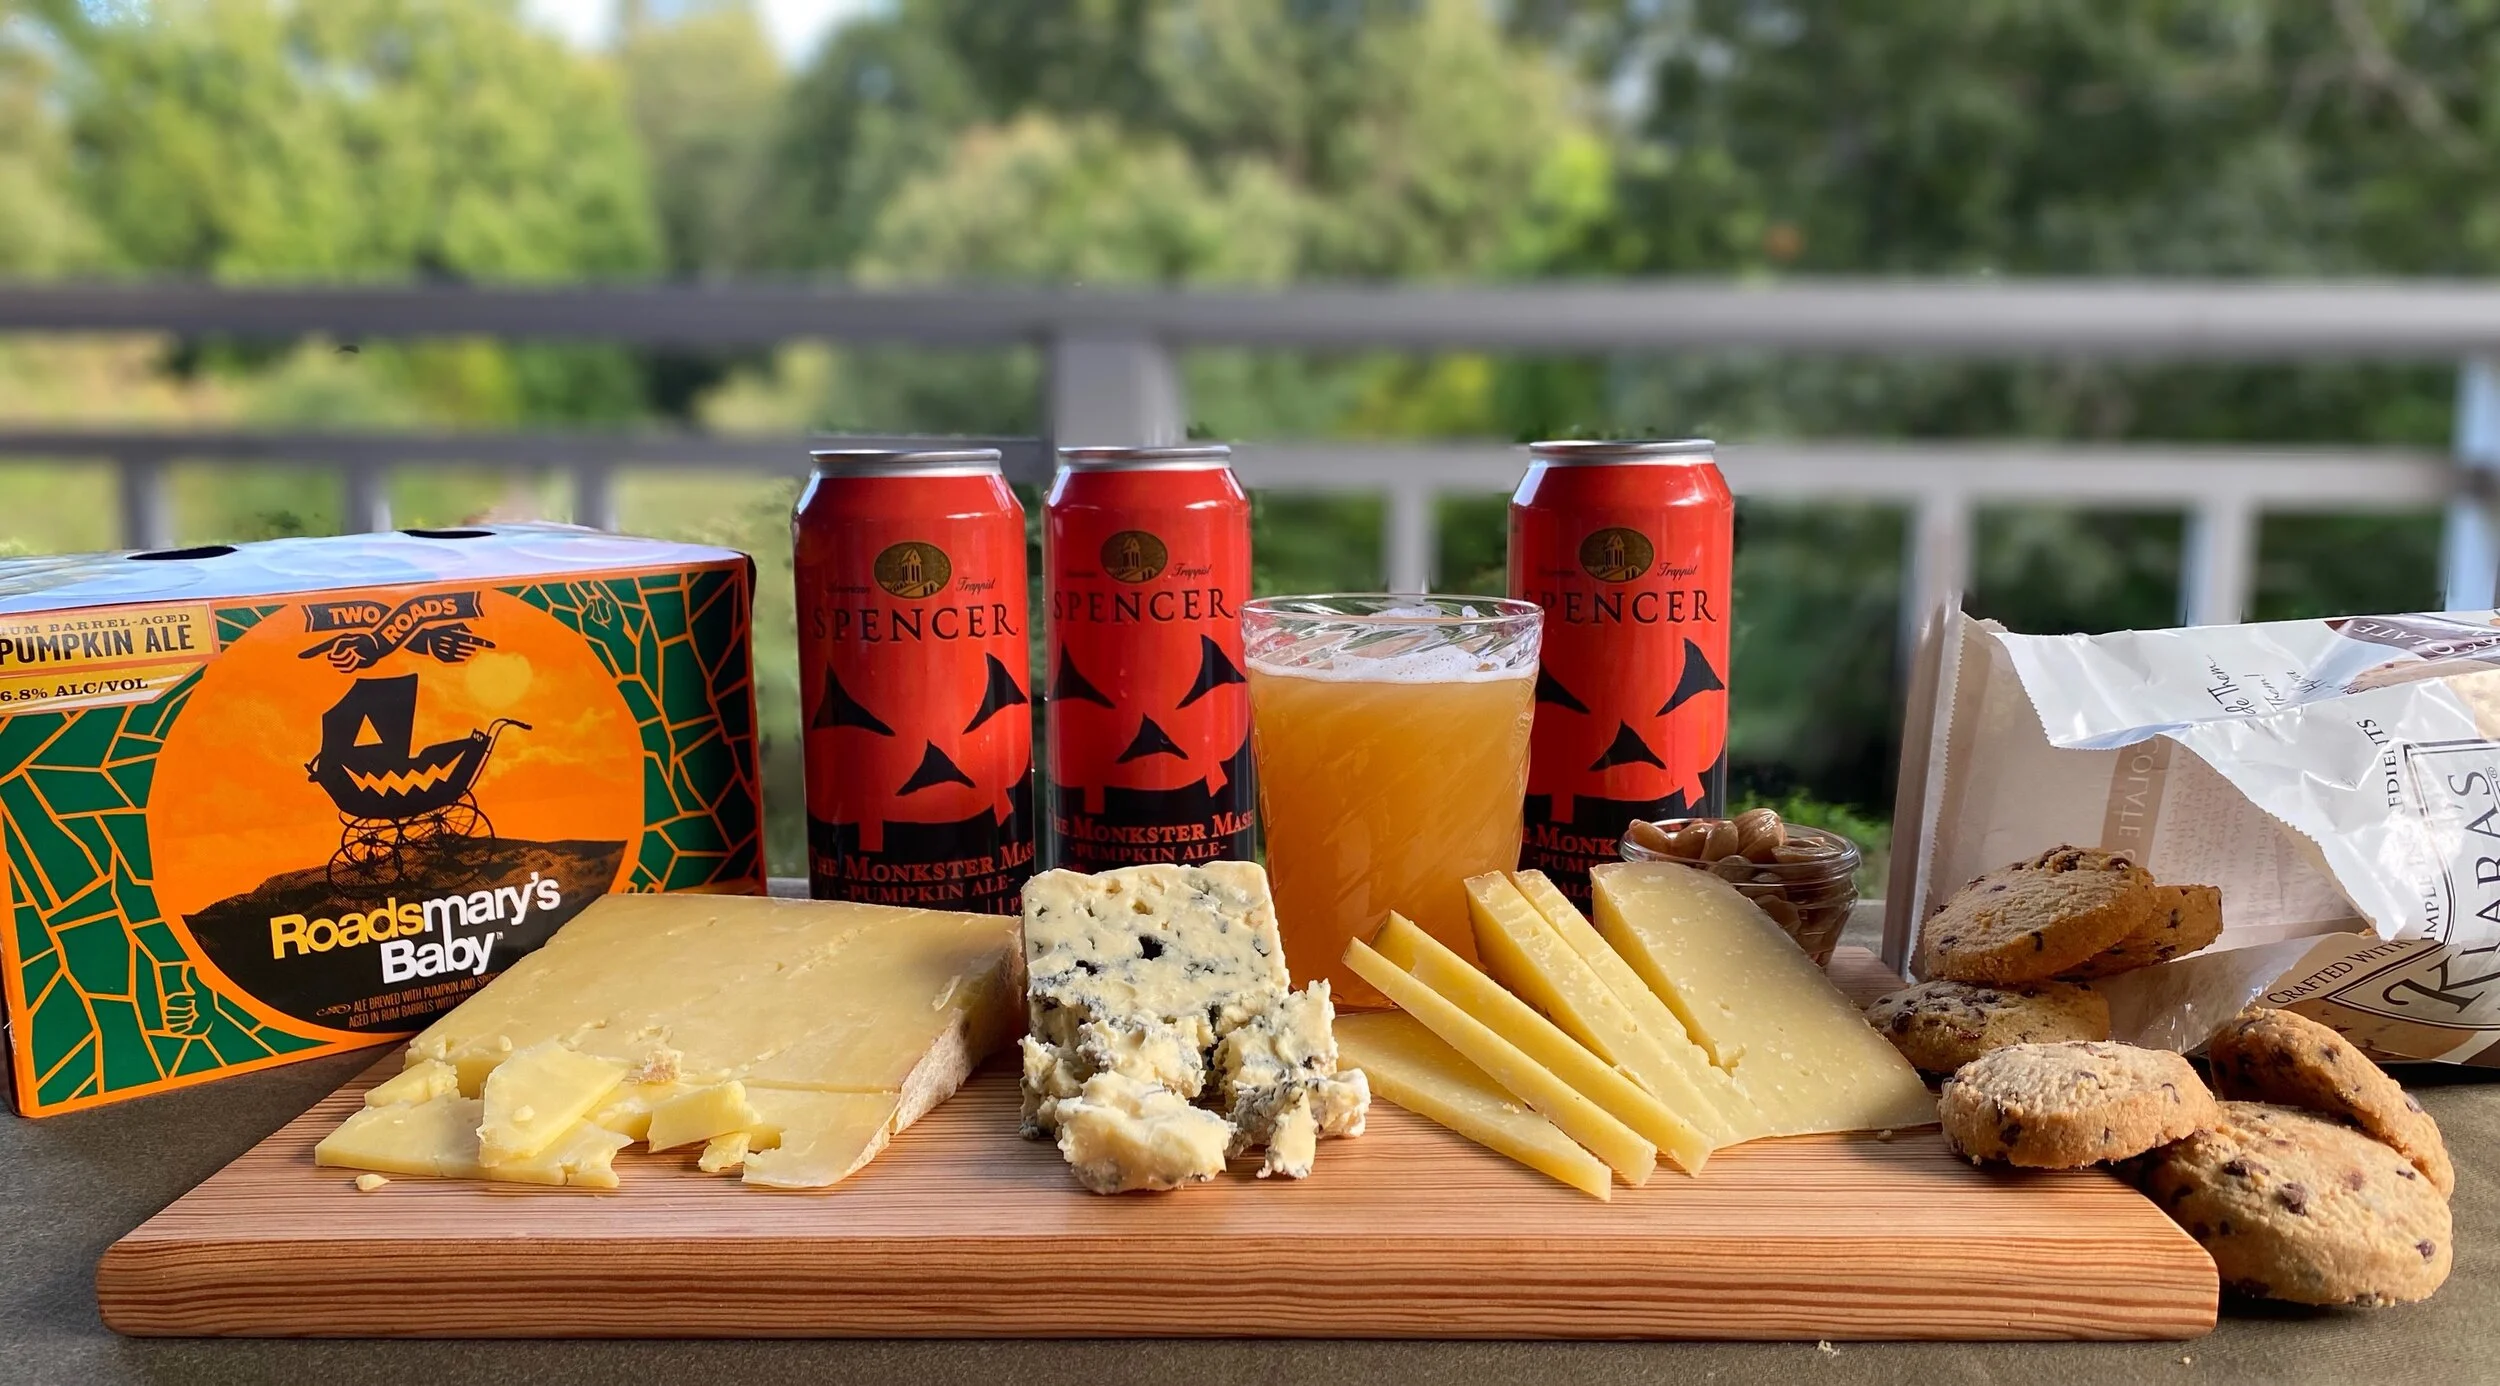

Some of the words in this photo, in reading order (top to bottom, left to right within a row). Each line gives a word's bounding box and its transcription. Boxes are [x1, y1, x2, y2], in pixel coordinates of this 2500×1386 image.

[50, 613, 191, 633] BARREL-AGED
[328, 606, 381, 625] TWO
[381, 598, 458, 645] ROADS
[813, 603, 1017, 643] SPENCER
[1053, 588, 1234, 624] SPENCER
[0, 629, 134, 665] PUMPKIN
[146, 625, 195, 653] ALE
[0, 688, 48, 702] 6.8%
[55, 678, 148, 697] ALC/VOL
[1073, 814, 1207, 844] MONKSTER
[1535, 823, 1618, 857] MONK
[844, 854, 996, 883] MONKSTER
[270, 871, 561, 960] Roadsmary's
[2417, 874, 2440, 941] IMPLE
[380, 931, 497, 984] Baby
[2267, 961, 2354, 1004] CRAFTED
[2347, 940, 2413, 967] WITH
[369, 992, 400, 1009] BREWED
[401, 988, 423, 1003] WITH
[423, 982, 459, 999] PUMPKIN
[460, 977, 476, 991] AND
[349, 1015, 369, 1029] AGED
[370, 1013, 380, 1024] IN
[381, 1010, 400, 1023] RUM
[401, 1001, 434, 1019] BARRELS
